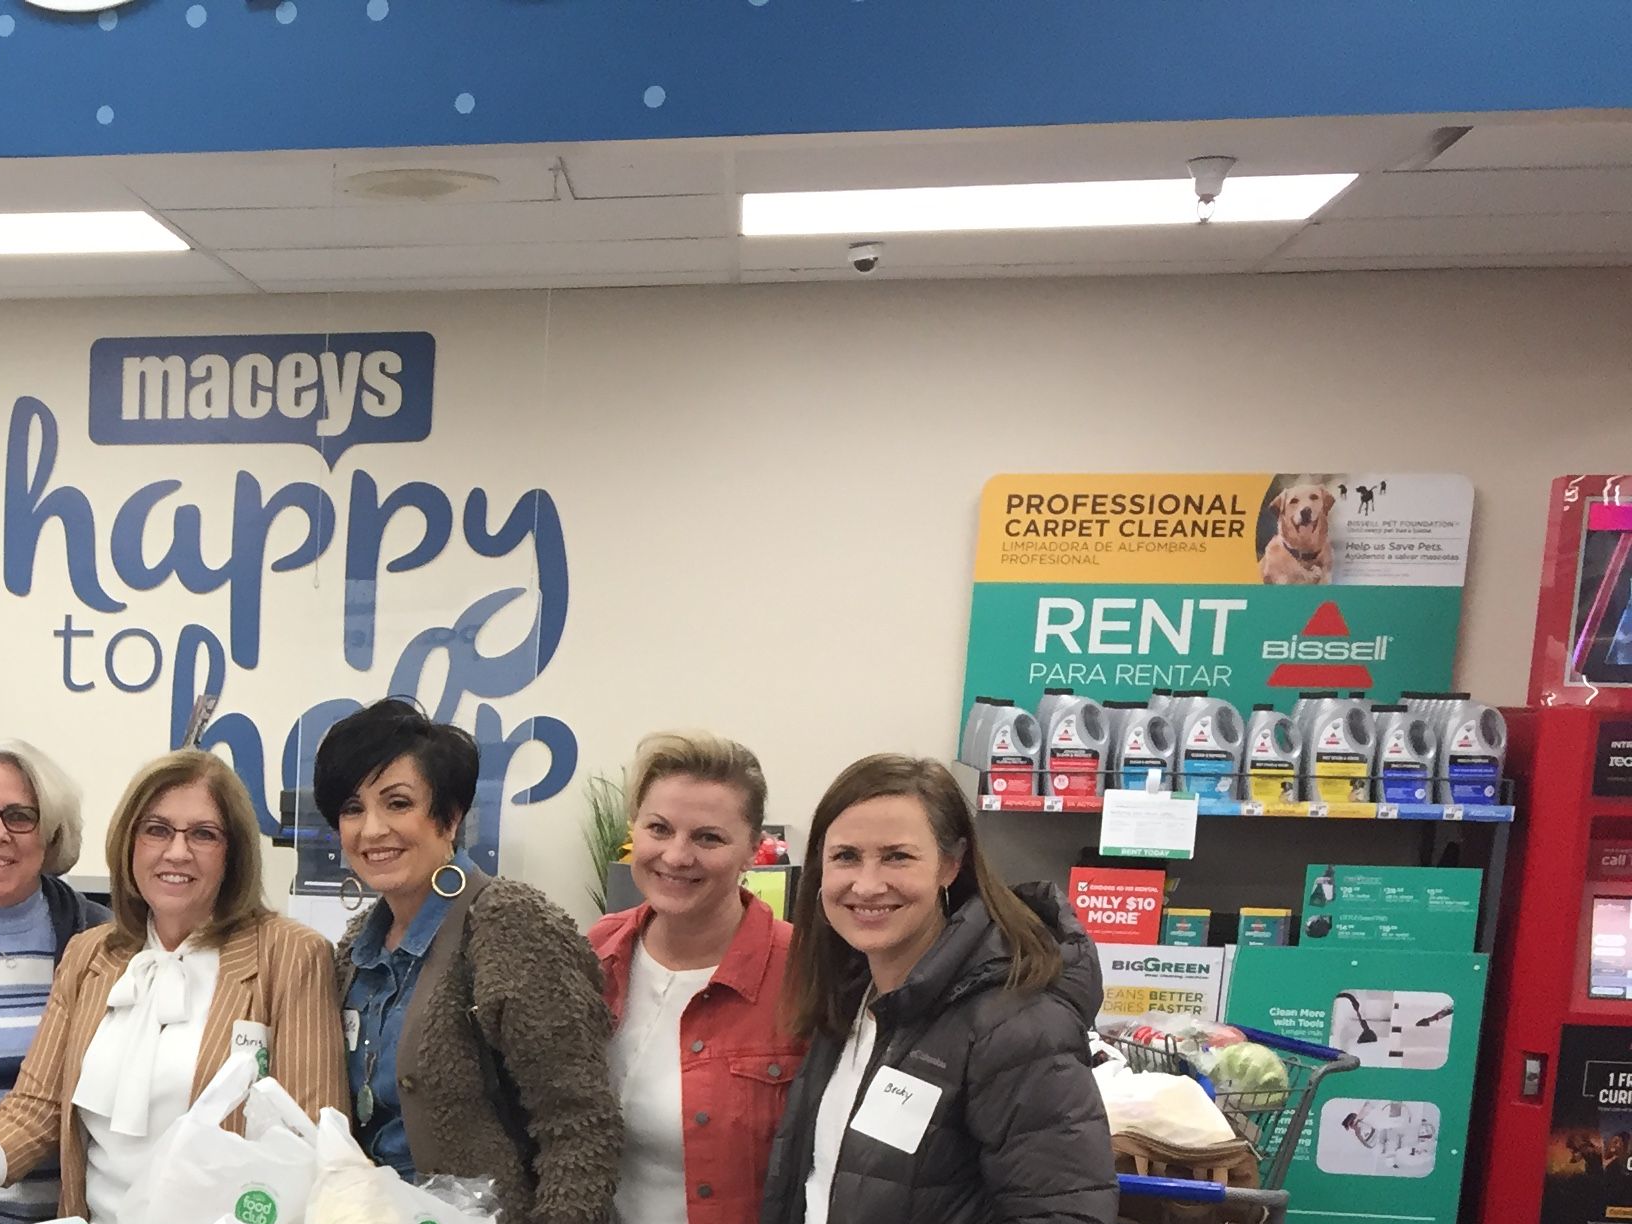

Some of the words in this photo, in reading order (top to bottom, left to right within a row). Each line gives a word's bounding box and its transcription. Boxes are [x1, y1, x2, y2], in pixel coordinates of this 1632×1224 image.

[121, 348, 404, 437] maceys
[1006, 493, 1247, 515] PROFESSIONAL
[1004, 518, 1110, 538] CARPET
[1119, 519, 1246, 539] CLEANER
[2, 395, 570, 699] happy
[1001, 541, 1084, 552] LIMPIADORA
[1094, 541, 1113, 552] DE
[1119, 541, 1208, 553] ALFOMBRAS
[1345, 542, 1371, 552] Help
[1388, 542, 1415, 551] Save
[1000, 553, 1101, 565] PROFESIONAL
[1034, 597, 1248, 656] RENT
[53, 614, 164, 693] to
[1029, 662, 1107, 685] PARA
[1115, 664, 1233, 687] RENTAR
[1601, 851, 1627, 867] call
[1076, 894, 1123, 910] ONLY
[1125, 896, 1156, 911] $10
[1105, 988, 1145, 1001] EANS
[1149, 991, 1204, 1003] BETTER
[1269, 1007, 1298, 1018] Clean
[1299, 1008, 1326, 1018] More
[1273, 1018, 1296, 1027] with
[1298, 1018, 1325, 1028] Tools
[1608, 1072, 1615, 1087] 1
[883, 1082, 914, 1105] Becky
[242, 1195, 272, 1215] food
